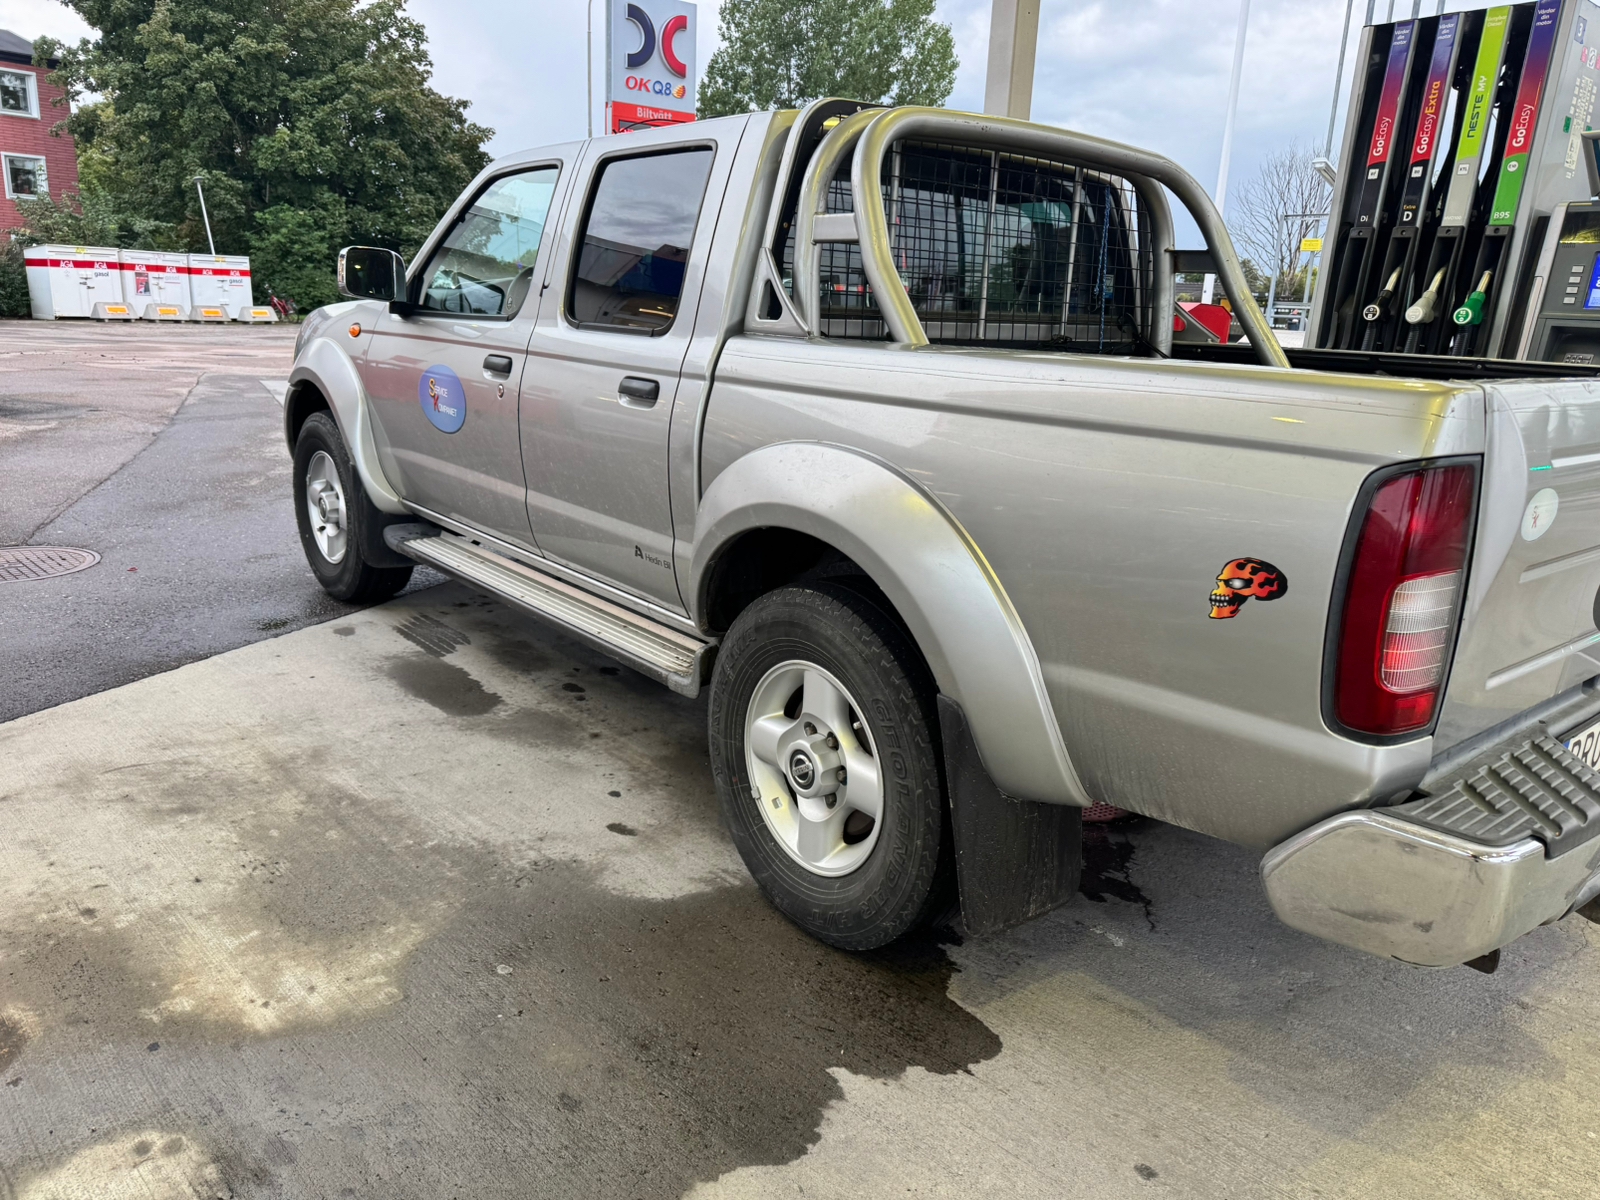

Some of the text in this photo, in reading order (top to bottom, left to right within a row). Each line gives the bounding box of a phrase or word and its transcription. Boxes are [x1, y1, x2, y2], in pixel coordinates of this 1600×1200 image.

[1467, 75, 1487, 139] NESTE MY
[636, 106, 673, 120] Biltvätt
[1512, 104, 1535, 147] GoEasy
[1372, 116, 1391, 156] GoEasy
[1403, 211, 1413, 221] D
[1493, 211, 1510, 219] B95
[60, 260, 74, 269] AGA
[94, 261, 108, 269] AGA
[134, 264, 147, 272] AGA
[202, 267, 214, 275] AGA
